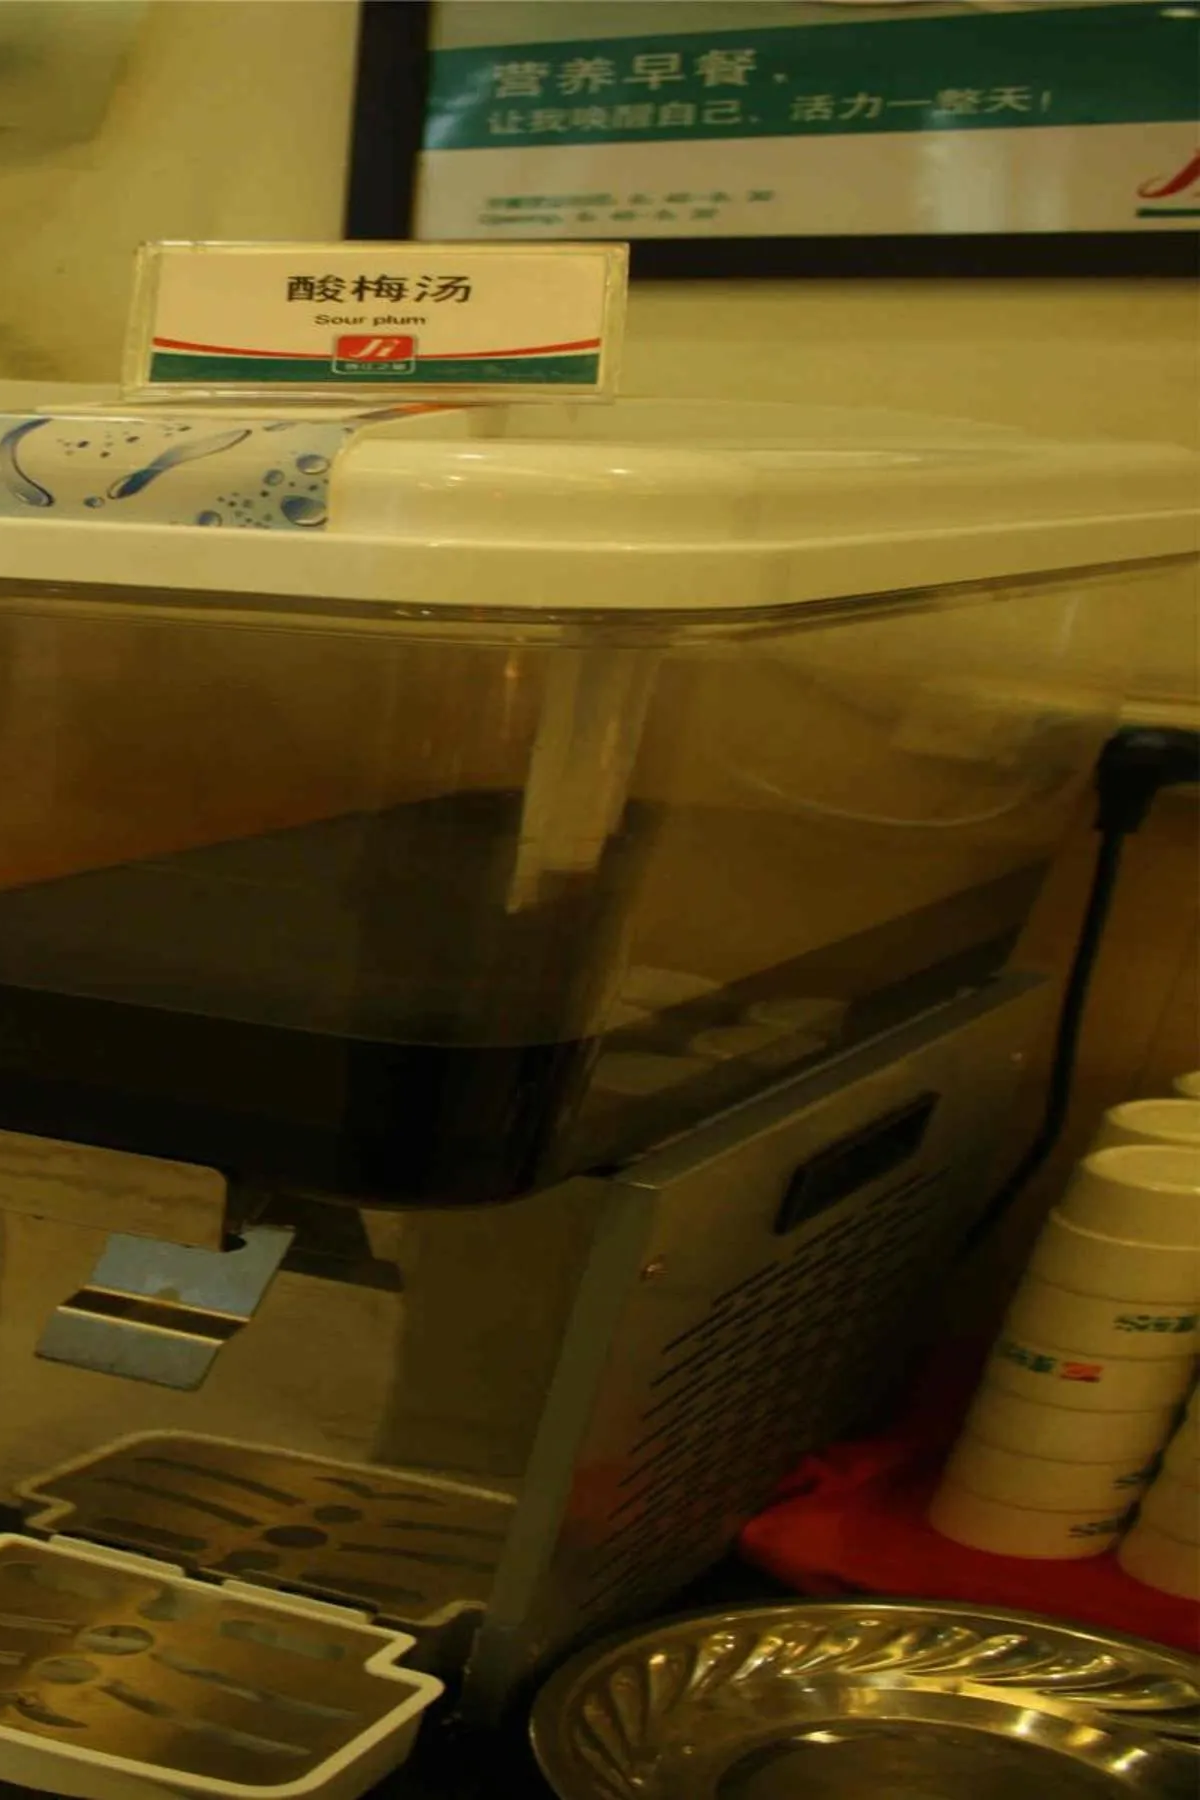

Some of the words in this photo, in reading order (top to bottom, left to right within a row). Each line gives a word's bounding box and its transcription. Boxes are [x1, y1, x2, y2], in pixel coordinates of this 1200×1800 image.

[286, 274, 471, 302] 酸梅汤
[314, 313, 366, 326] Sour
[372, 313, 427, 327] plum
